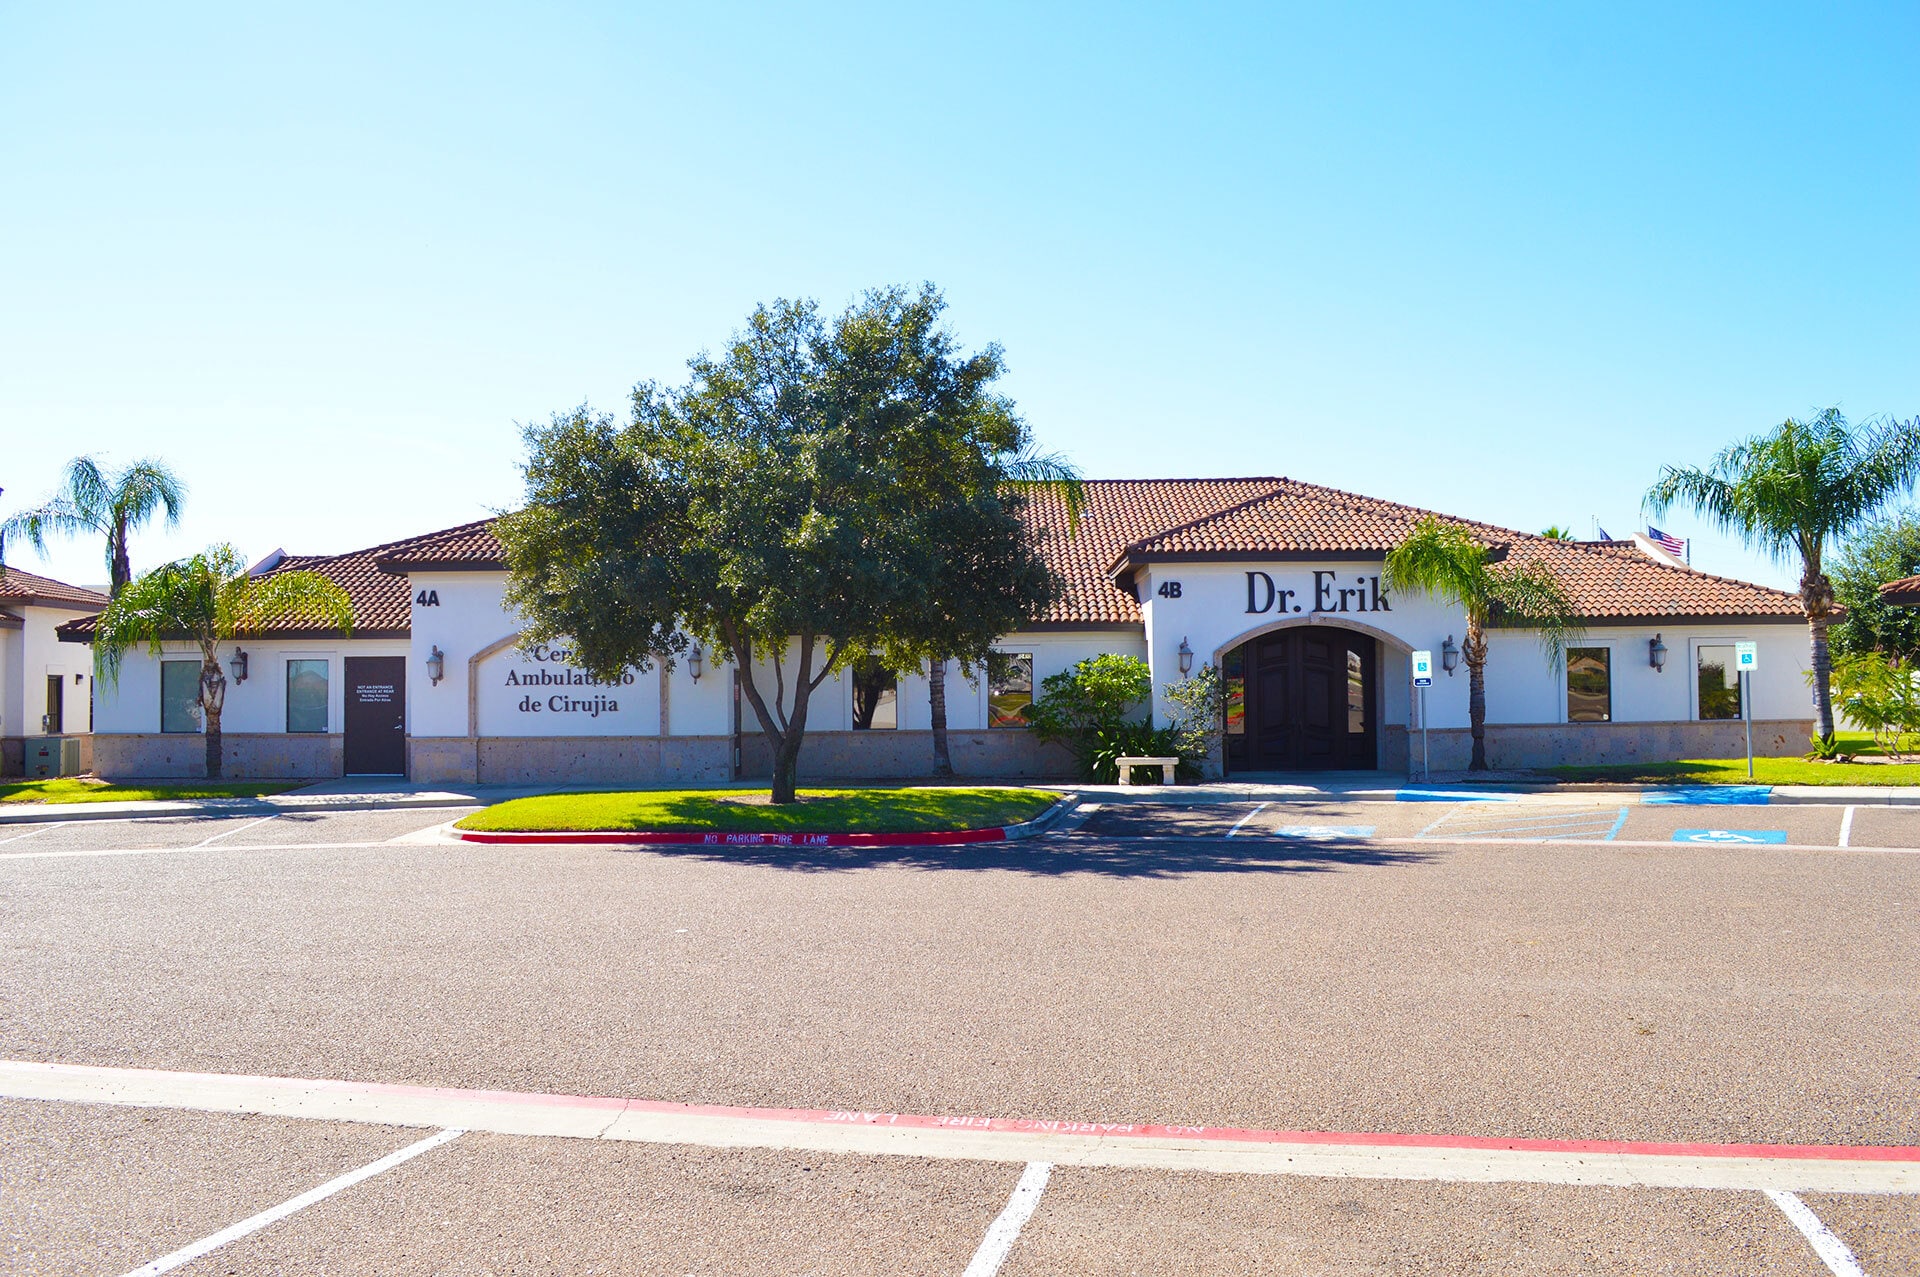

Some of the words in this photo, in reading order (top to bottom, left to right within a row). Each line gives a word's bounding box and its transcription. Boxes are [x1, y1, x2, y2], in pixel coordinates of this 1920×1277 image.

[416, 590, 440, 607] 4A
[1158, 581, 1182, 599] 4B
[1245, 571, 1302, 614] Dr.
[1312, 570, 1393, 613] Erik
[519, 695, 541, 713] de
[548, 695, 619, 718] Cirujia
[704, 834, 718, 844] NO
[726, 834, 765, 844] PARKING
[773, 835, 793, 844] FIRE
[803, 835, 829, 845] LANE
[823, 1110, 899, 1125] LANE
